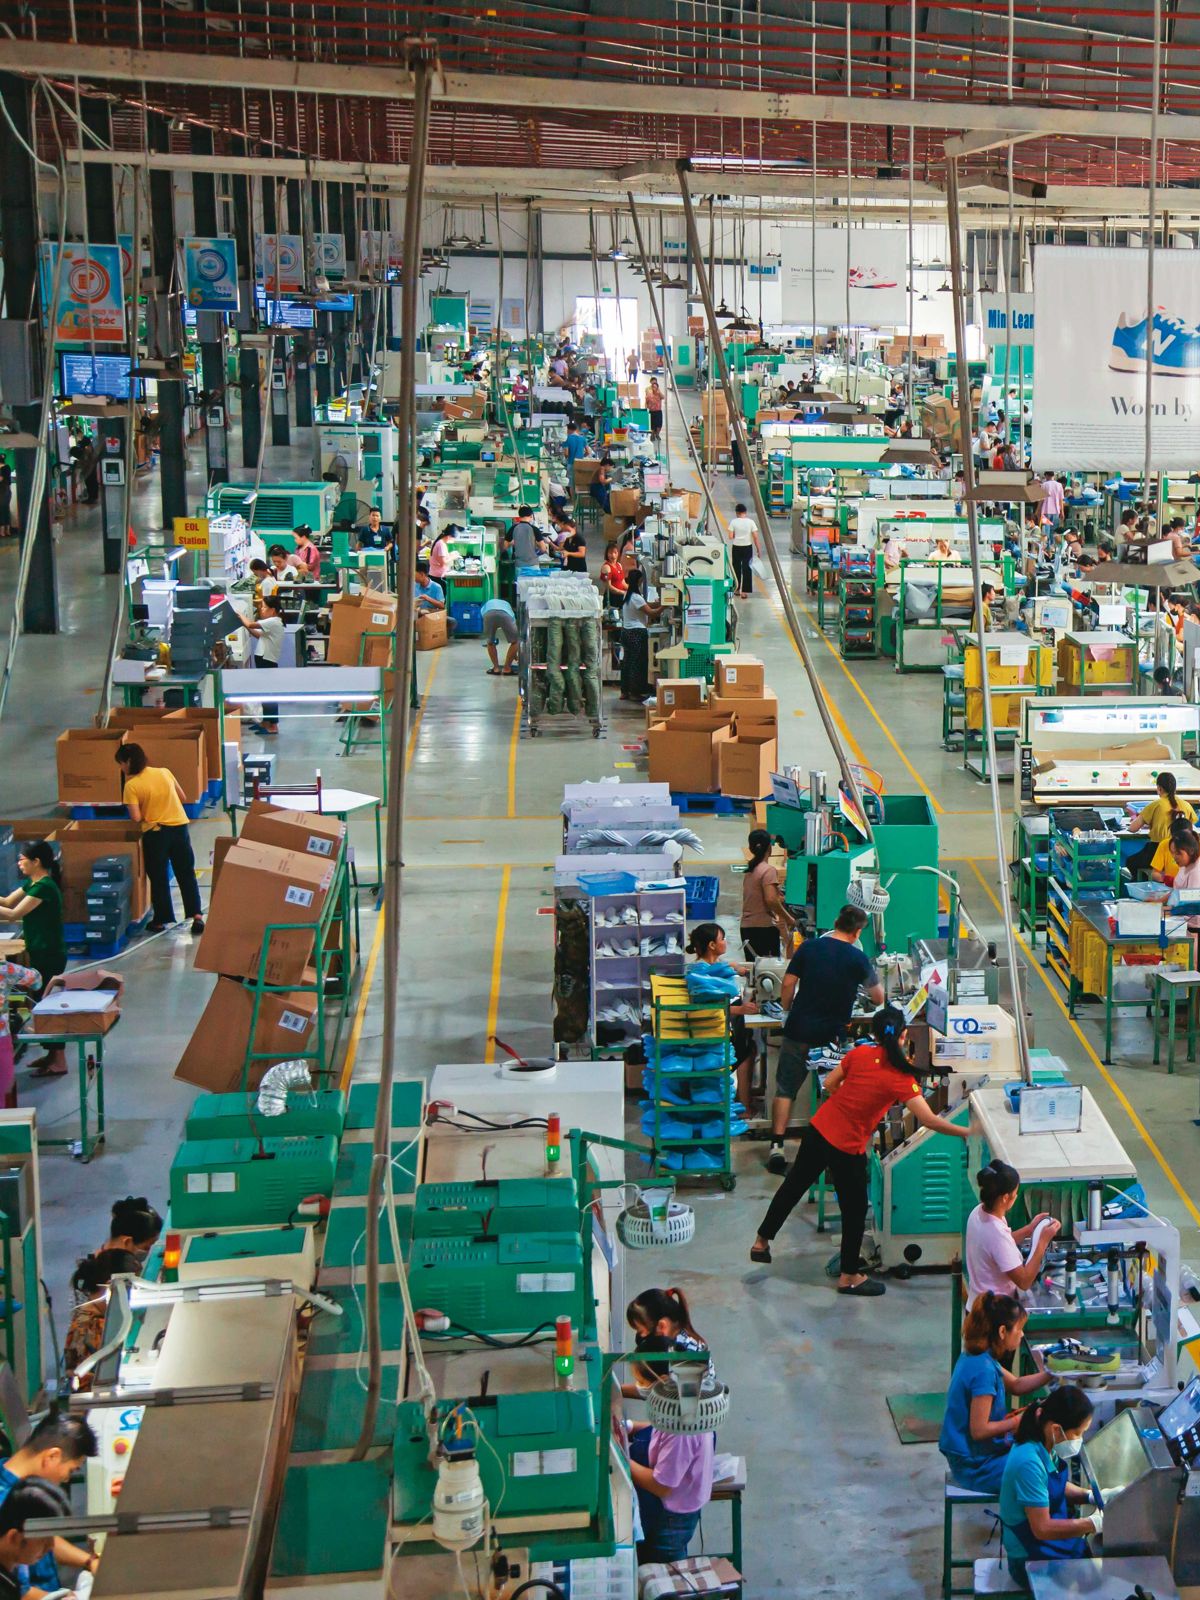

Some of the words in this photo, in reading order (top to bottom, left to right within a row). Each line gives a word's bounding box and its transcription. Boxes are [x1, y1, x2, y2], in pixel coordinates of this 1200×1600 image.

[988, 309, 1008, 329] Min
[1174, 396, 1193, 422] by
[184, 522, 200, 531] EOL
[178, 536, 207, 545] Station
